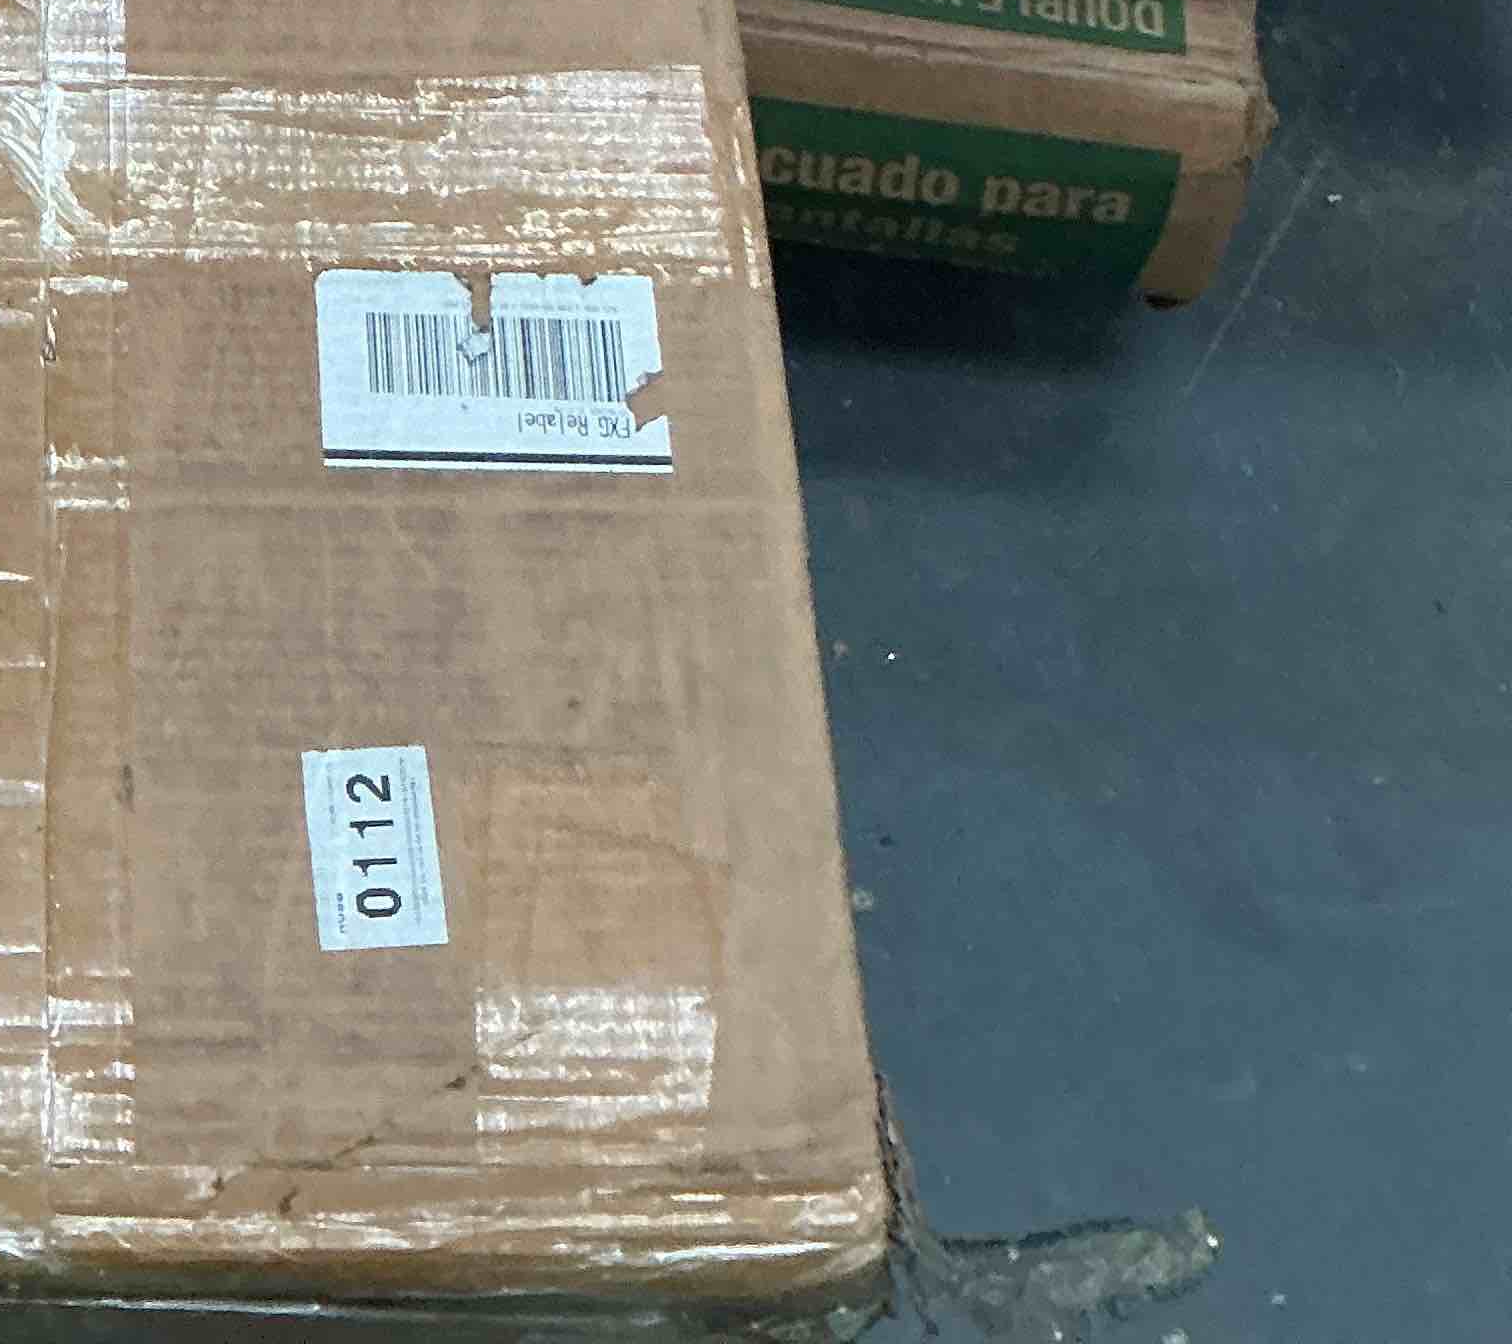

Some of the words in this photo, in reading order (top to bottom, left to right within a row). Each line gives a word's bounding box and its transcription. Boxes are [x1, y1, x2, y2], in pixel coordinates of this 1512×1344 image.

[981, 175, 1132, 226] para
[518, 412, 589, 438] Relabel
[597, 415, 631, 439] FXG
[347, 772, 402, 920] 0112
